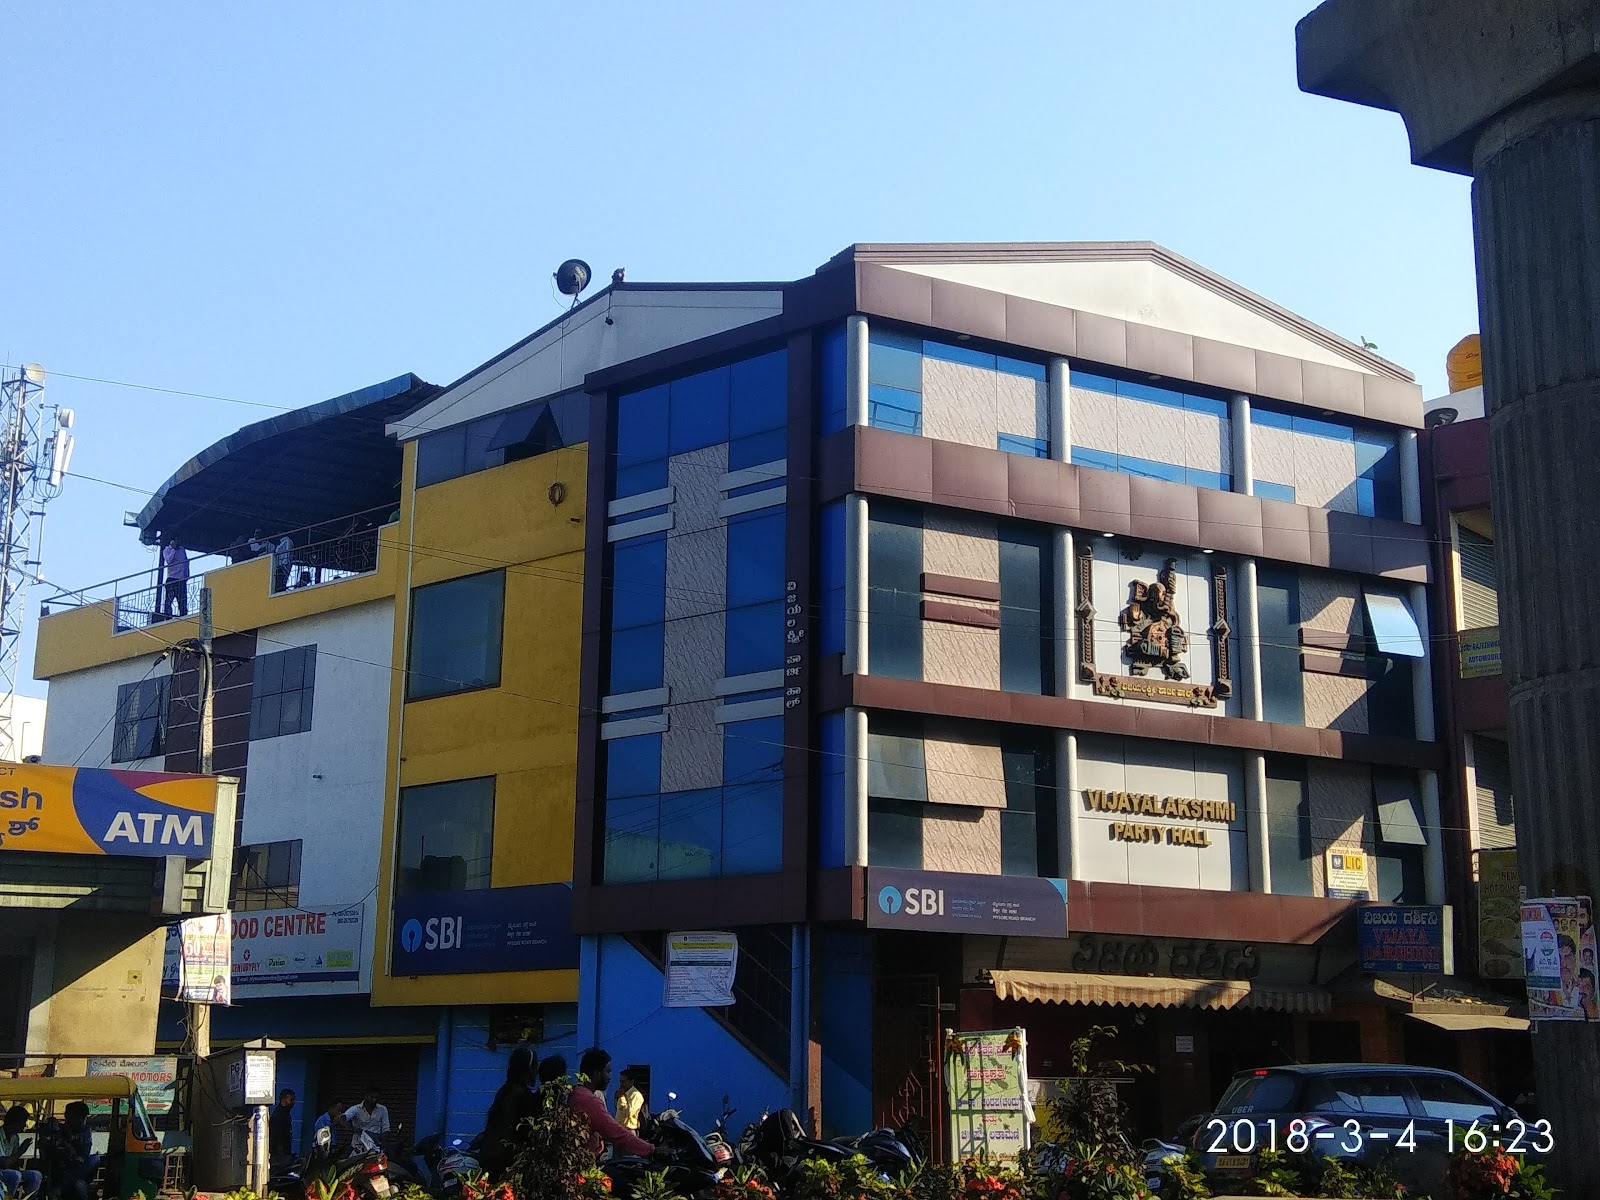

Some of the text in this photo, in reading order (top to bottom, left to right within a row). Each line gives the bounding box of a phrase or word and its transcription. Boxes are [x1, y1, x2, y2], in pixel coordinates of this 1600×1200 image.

[1084, 788, 1236, 822] VIJAYALAKSHMI
[103, 811, 204, 846] ATM
[1112, 822, 1213, 846] PARTY HALL
[1345, 856, 1361, 870] LIC
[905, 888, 944, 916] SBI
[264, 913, 327, 938] CENTRE
[1363, 910, 1398, 925] ವಿಜಯ
[425, 916, 463, 951] SBI
[1373, 928, 1429, 945] VIJAYA
[132, 1072, 173, 1082] MOTORS
[1232, 1105, 1254, 1114] UBER
